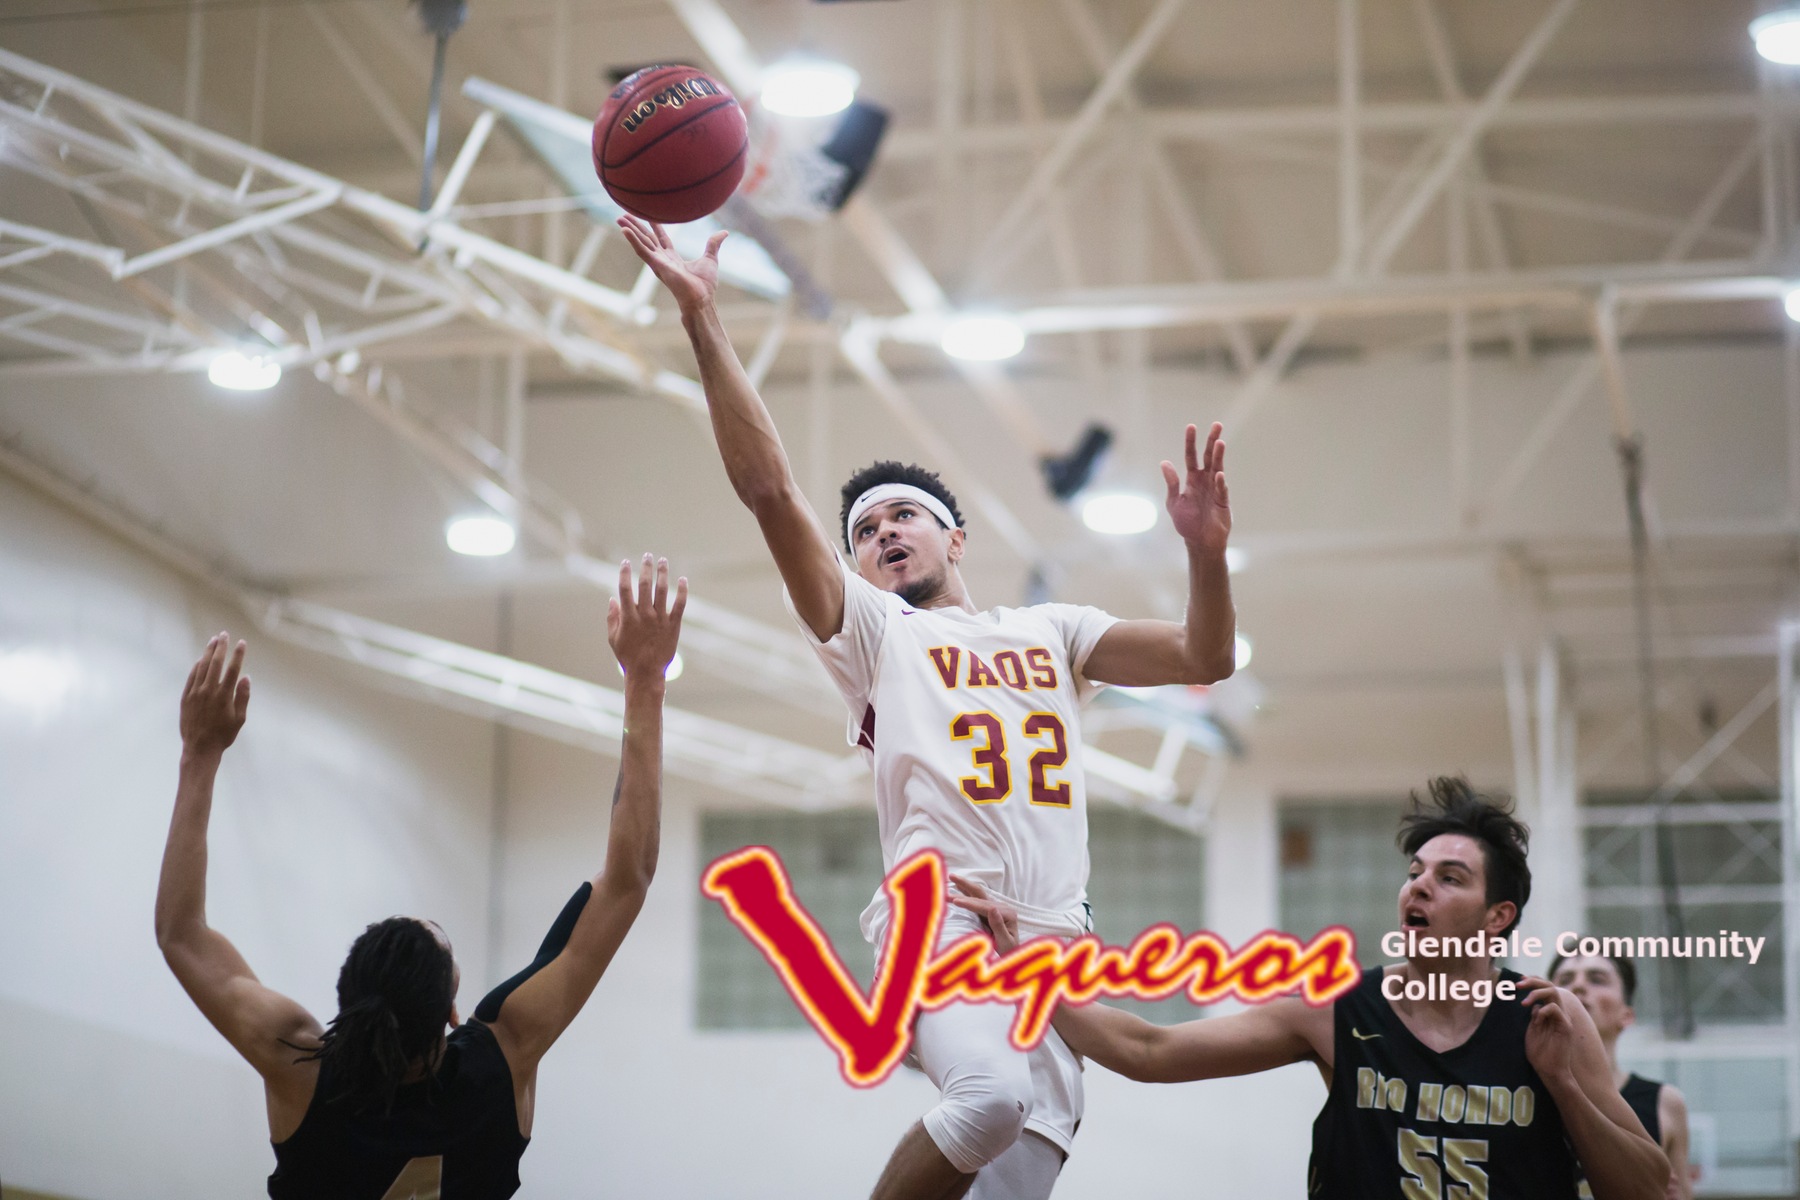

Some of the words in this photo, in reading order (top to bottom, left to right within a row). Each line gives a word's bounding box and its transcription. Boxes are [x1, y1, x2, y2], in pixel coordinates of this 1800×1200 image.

[620, 77, 720, 133] Wilson
[928, 645, 1057, 691] VAQS
[950, 711, 1072, 808] 32
[1357, 1067, 1407, 1113] RIO
[1416, 1082, 1535, 1127] HONDO
[1398, 1127, 1489, 1200] 55
